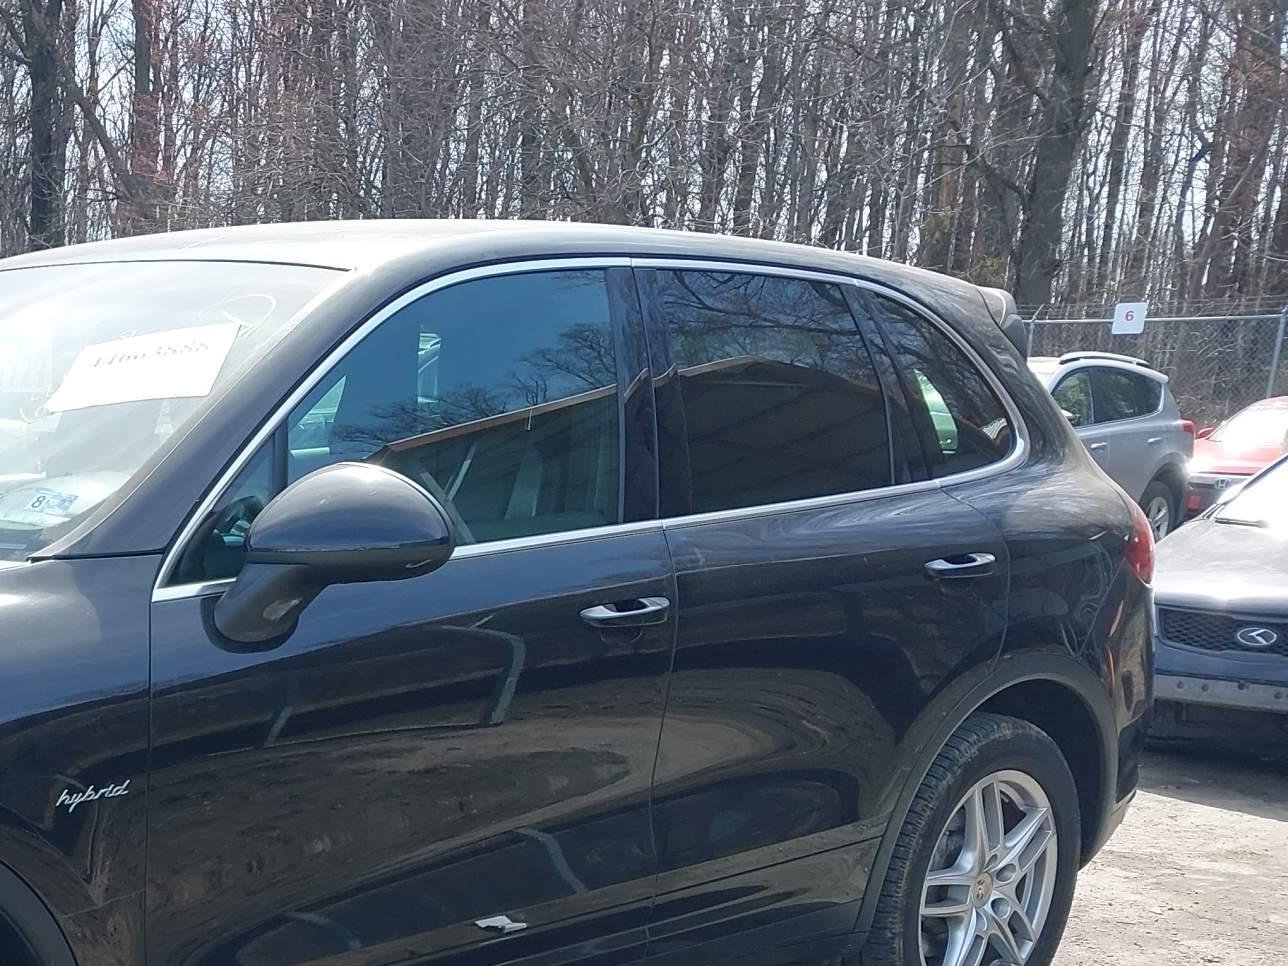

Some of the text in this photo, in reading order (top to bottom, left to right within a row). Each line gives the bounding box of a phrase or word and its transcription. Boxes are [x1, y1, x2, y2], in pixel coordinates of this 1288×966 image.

[1125, 310, 1134, 322] 6
[31, 495, 46, 508] 8
[55, 779, 130, 813] hybrid
